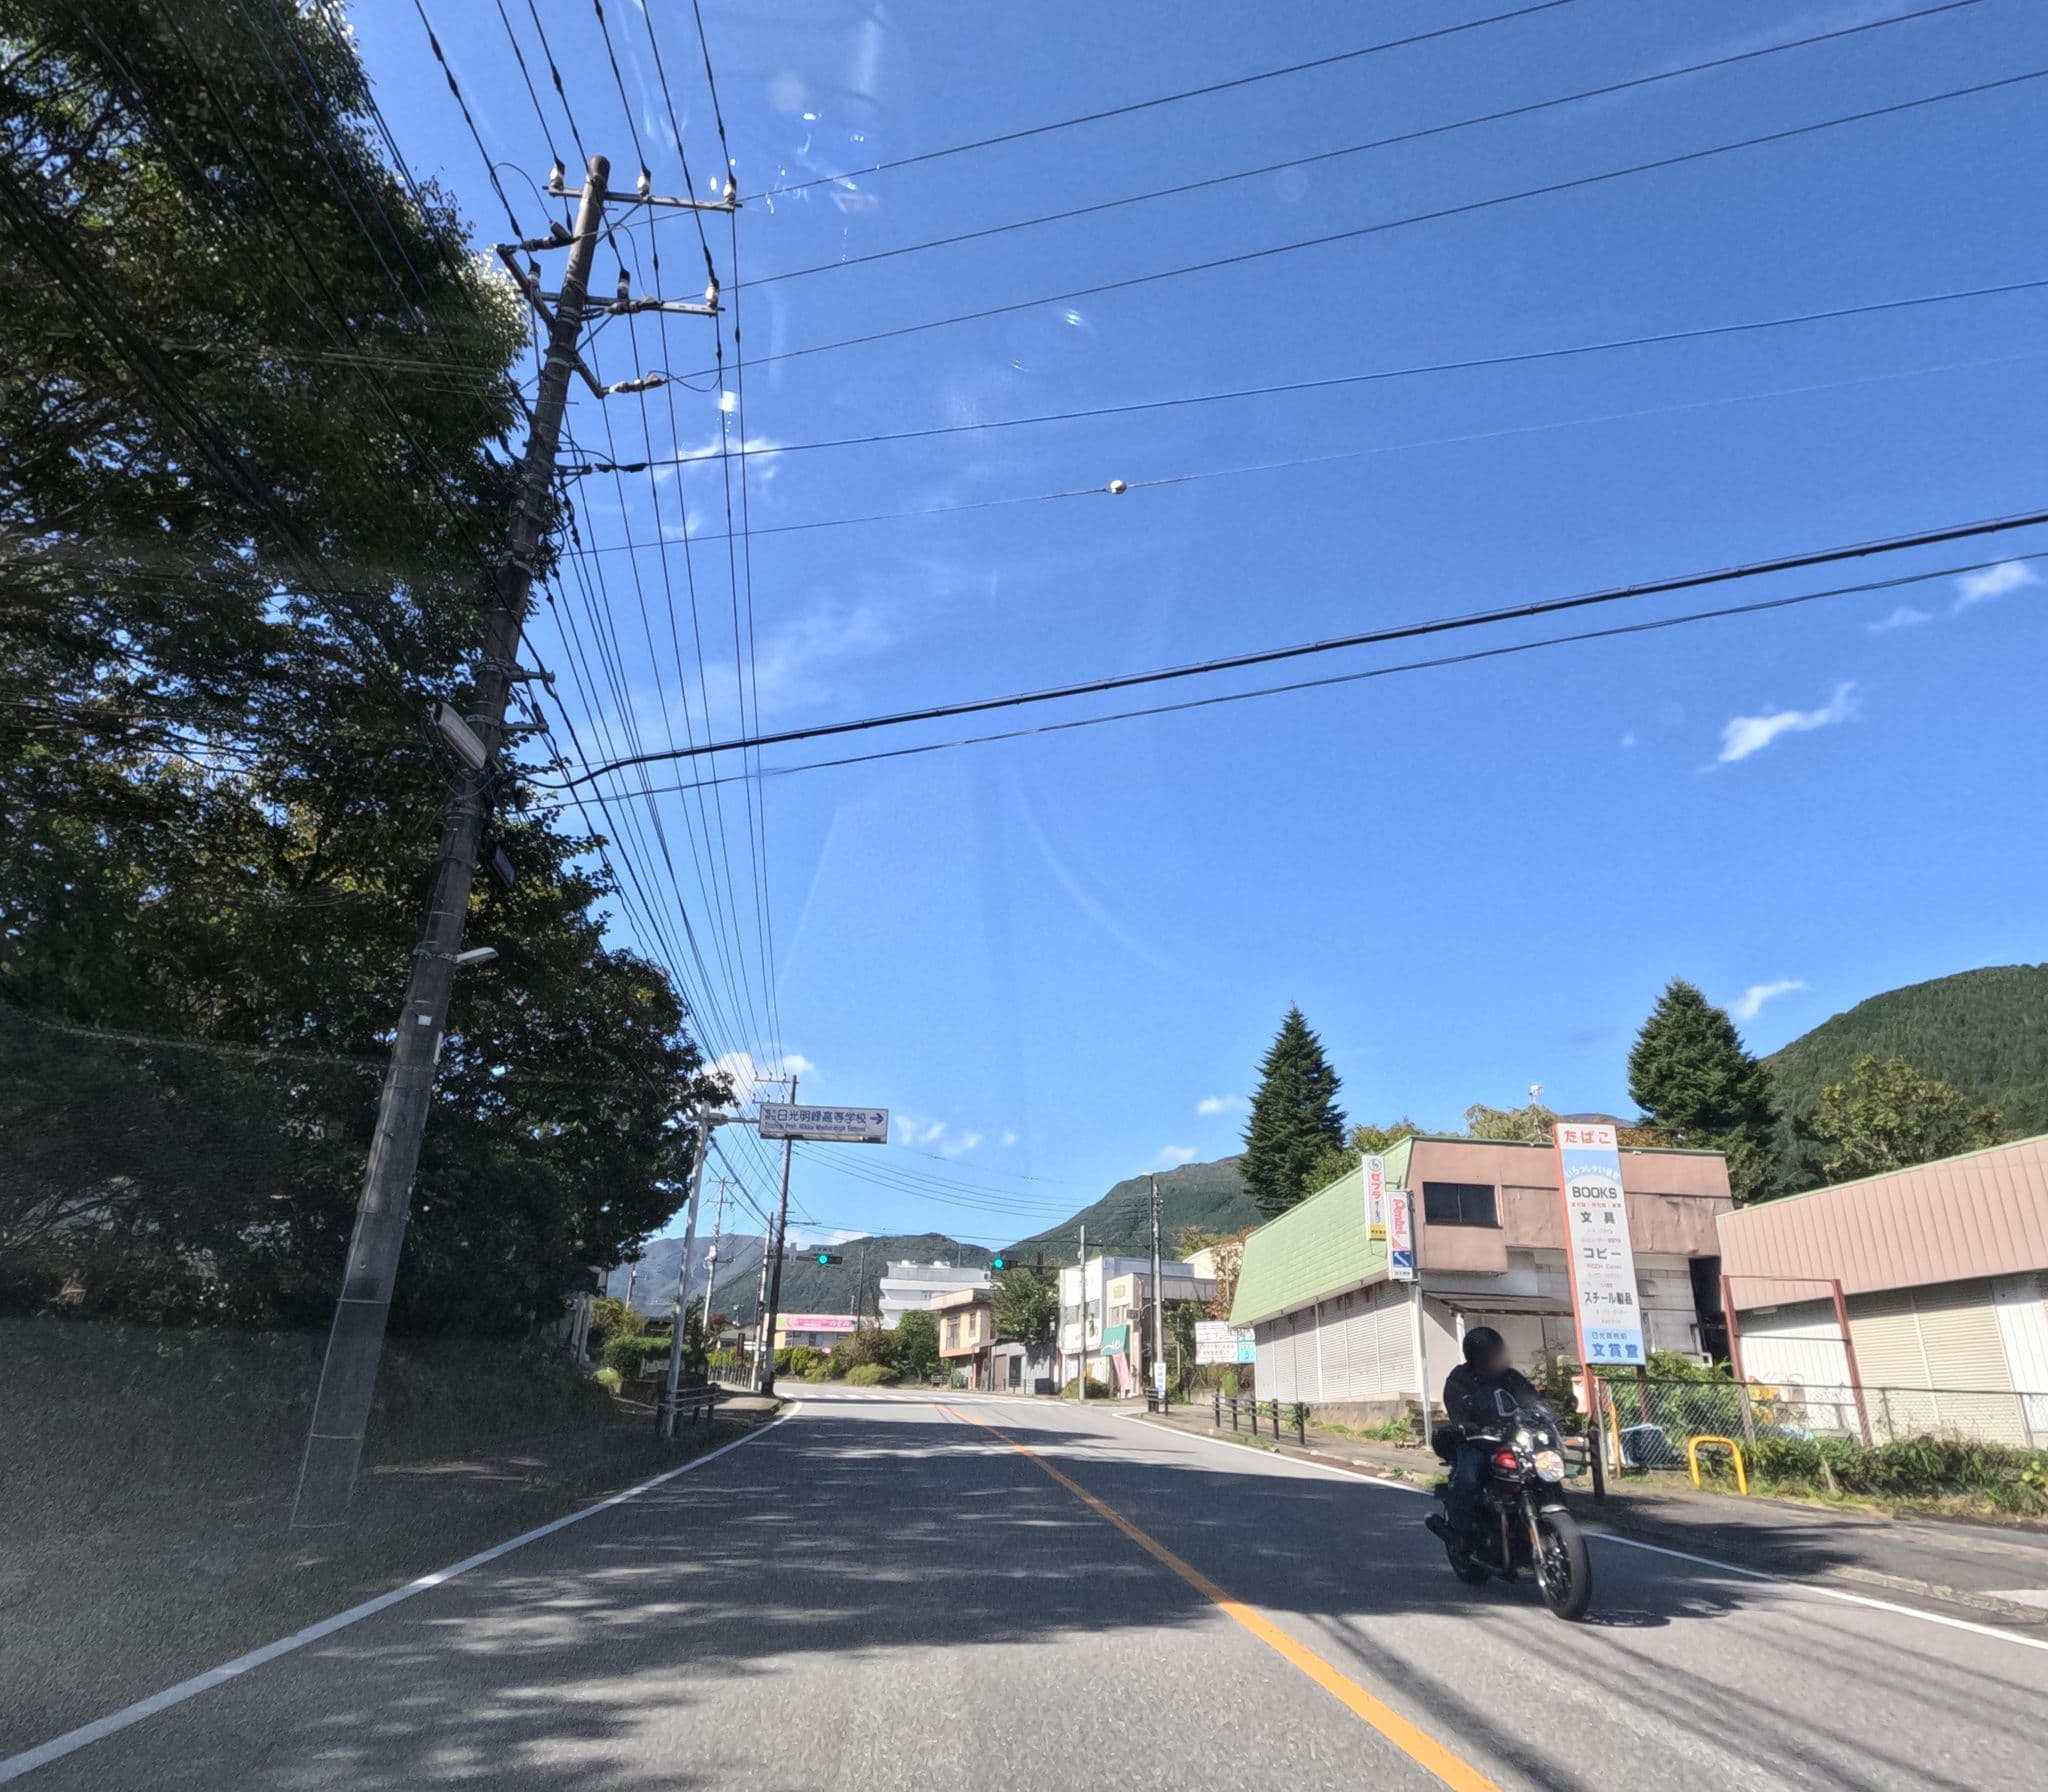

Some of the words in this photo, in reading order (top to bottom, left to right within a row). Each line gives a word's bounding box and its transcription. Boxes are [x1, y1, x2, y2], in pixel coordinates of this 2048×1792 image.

[1564, 1130, 1611, 1144] たばこ
[1572, 1186, 1617, 1199] BOOKS
[1583, 1247, 1622, 1260] コピー
[1584, 1291, 1633, 1305] スチール製品
